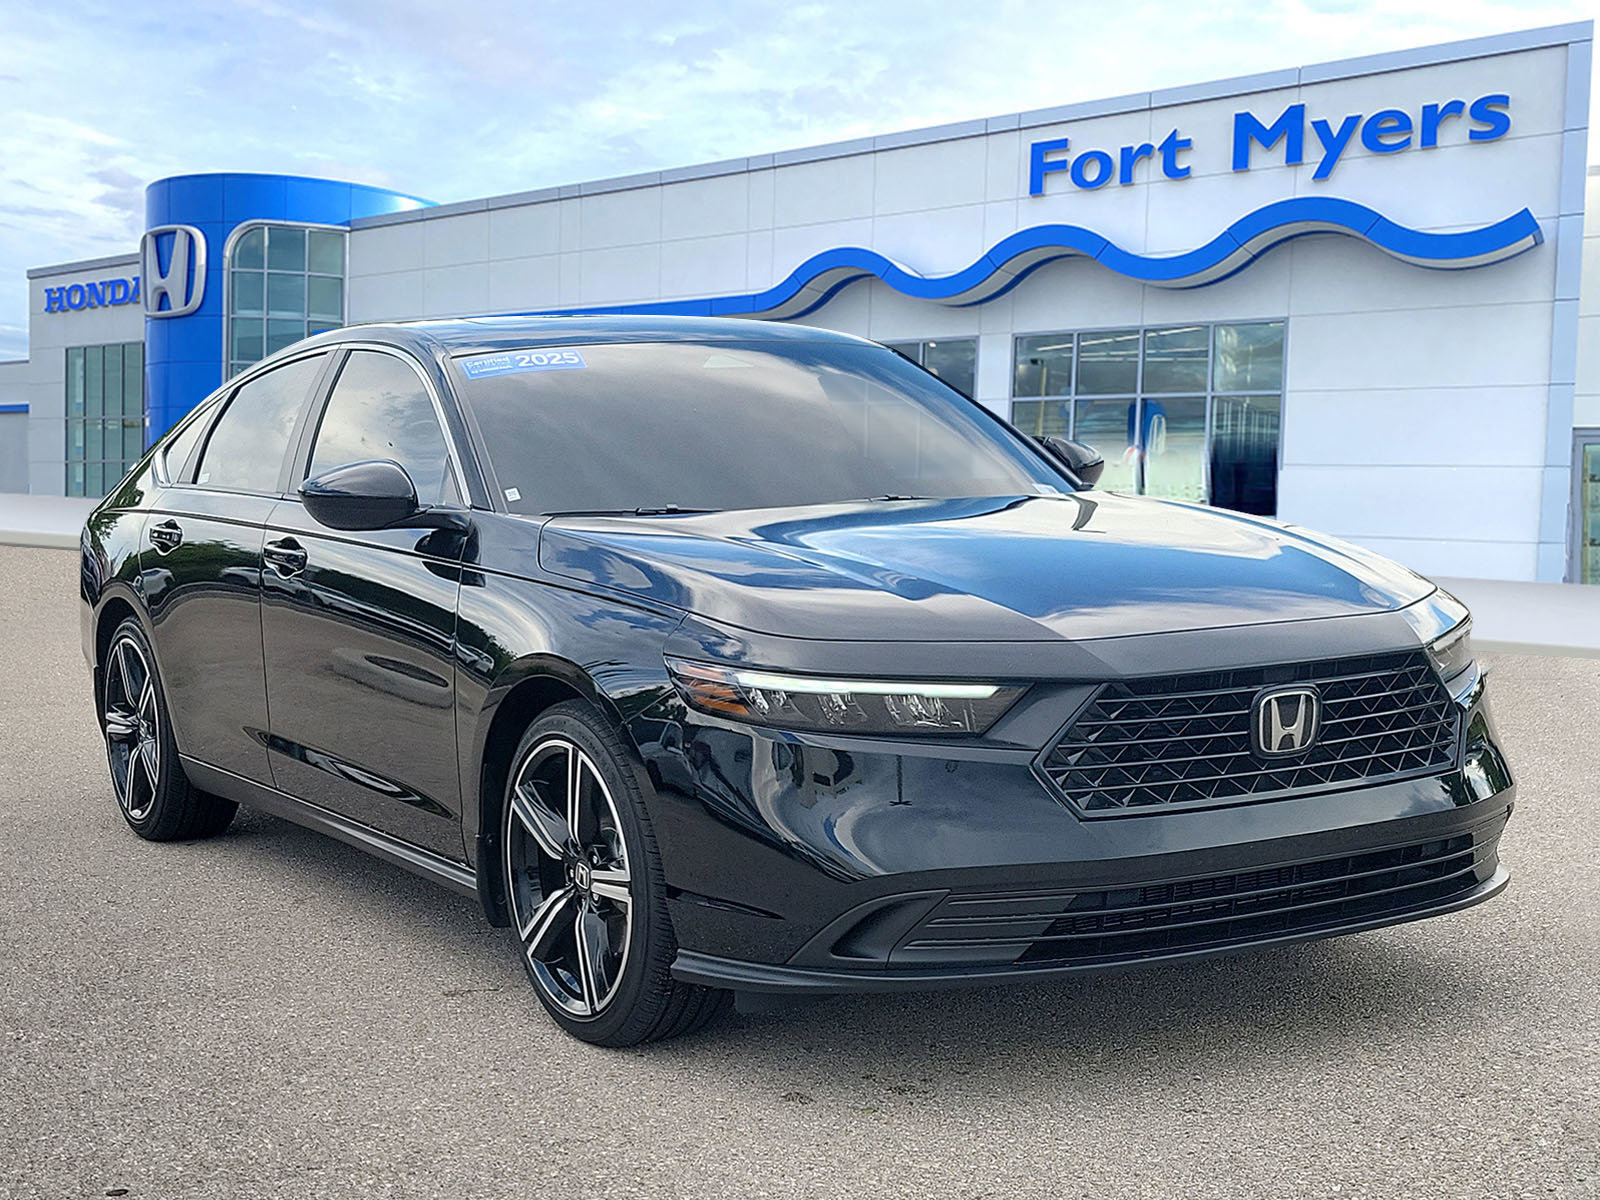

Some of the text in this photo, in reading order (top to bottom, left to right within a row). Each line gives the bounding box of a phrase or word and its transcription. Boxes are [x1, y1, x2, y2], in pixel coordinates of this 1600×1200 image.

[1029, 93, 1511, 196] Fort Myers
[515, 352, 580, 367] 2025
